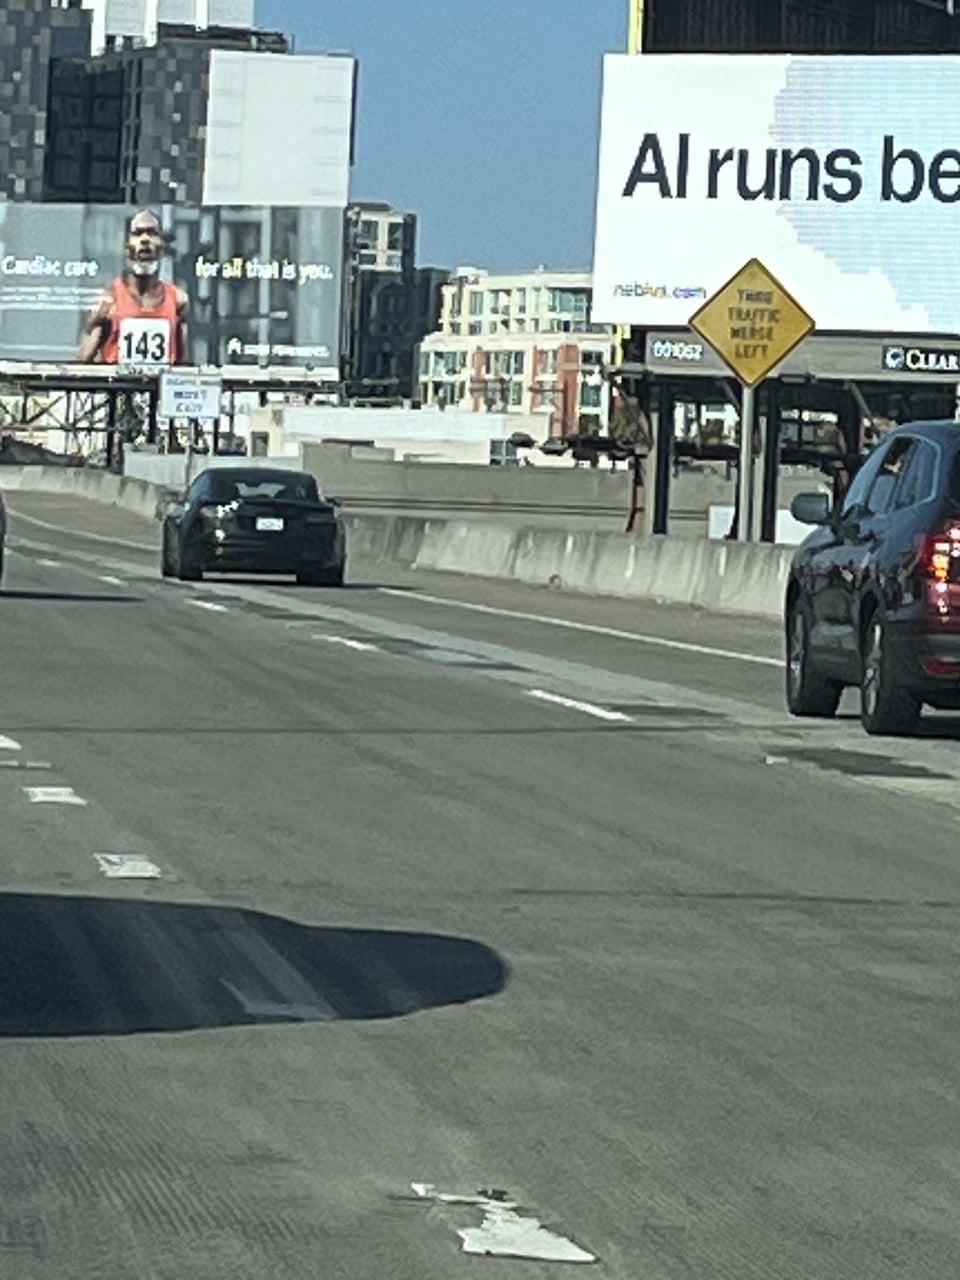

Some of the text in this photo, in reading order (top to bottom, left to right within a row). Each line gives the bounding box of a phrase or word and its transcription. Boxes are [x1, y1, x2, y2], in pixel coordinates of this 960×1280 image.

[622, 133, 690, 199] AI
[706, 147, 862, 203] runs
[195, 256, 219, 277] for
[222, 258, 243, 278] all
[245, 257, 279, 279] that
[282, 260, 296, 279] is
[737, 289, 774, 304] THRU
[728, 307, 781, 323] TRAFFIC
[730, 326, 774, 342] MERGE
[124, 332, 165, 361] 143
[735, 344, 769, 360] LEFT
[906, 349, 958, 370] CLEAR
